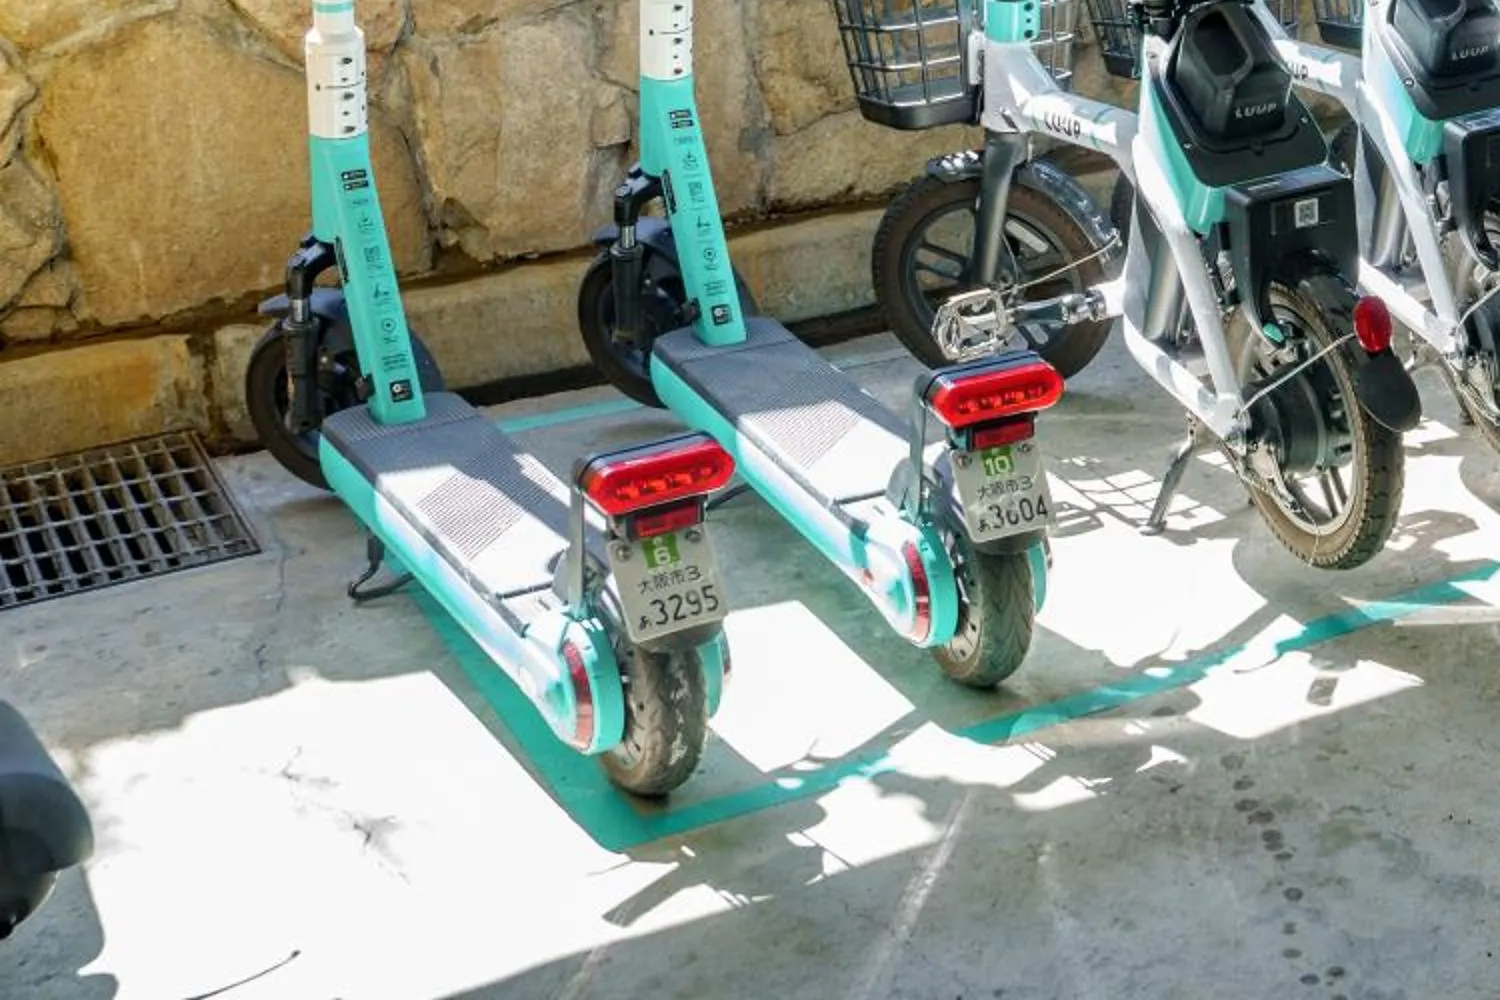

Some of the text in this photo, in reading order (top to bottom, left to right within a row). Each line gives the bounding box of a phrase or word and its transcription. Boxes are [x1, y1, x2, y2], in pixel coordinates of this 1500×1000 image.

[1234, 102, 1277, 119] LUUP
[1043, 110, 1081, 139] LUUP
[985, 455, 1010, 476] 10
